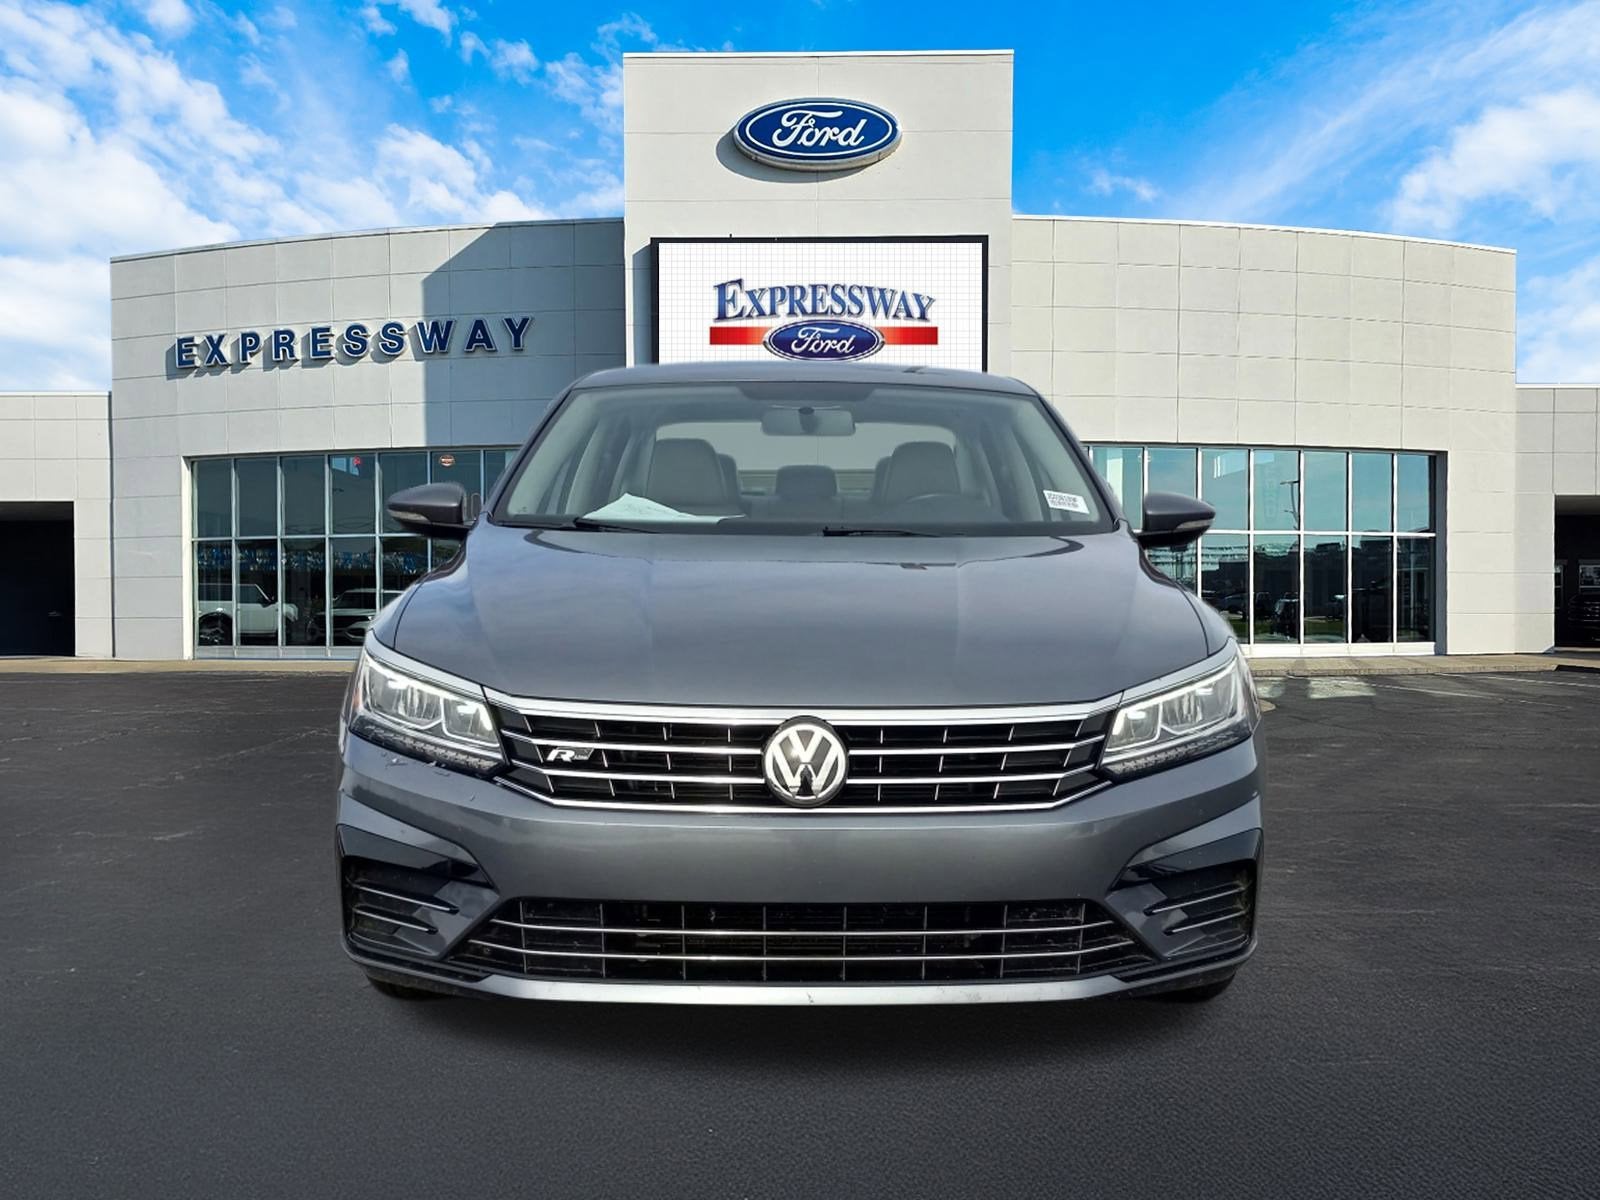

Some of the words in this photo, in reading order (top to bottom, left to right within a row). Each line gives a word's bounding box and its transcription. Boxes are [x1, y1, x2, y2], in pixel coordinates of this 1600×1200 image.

[772, 109, 865, 148] Ford
[713, 278, 935, 322] EXPRESSWAY
[175, 315, 533, 369] EXPRESSWAY
[790, 326, 855, 354] Ford
